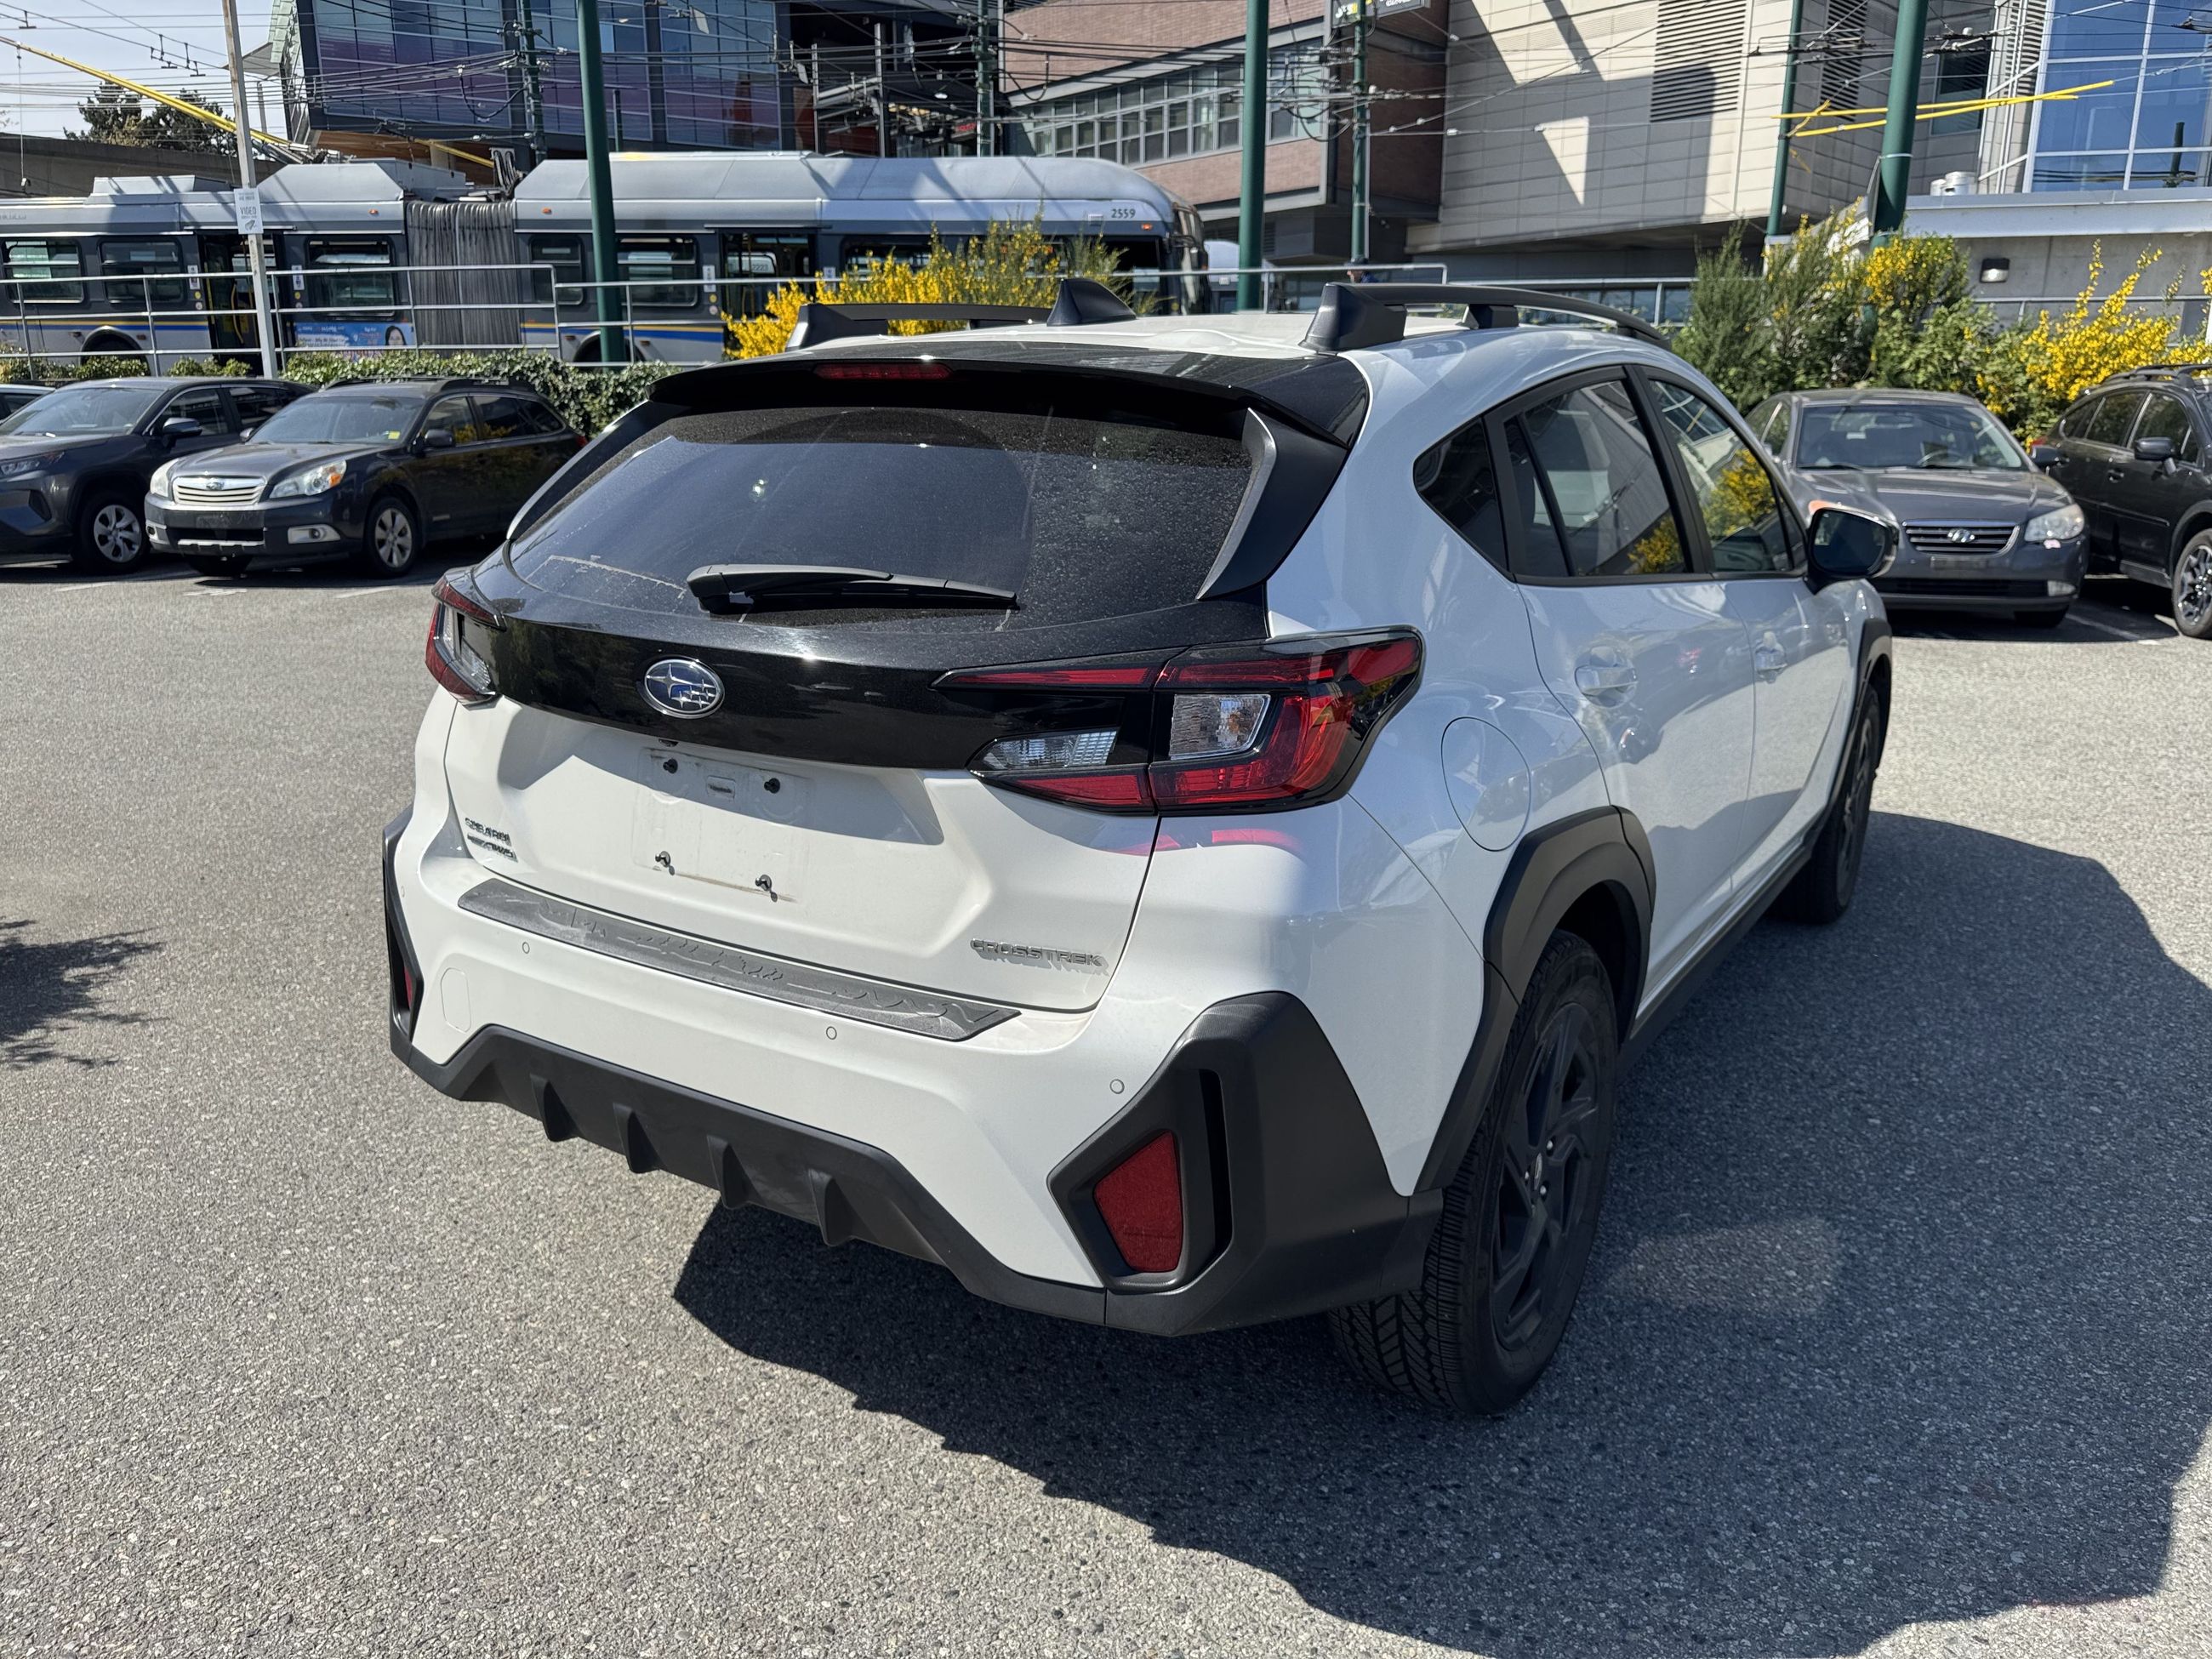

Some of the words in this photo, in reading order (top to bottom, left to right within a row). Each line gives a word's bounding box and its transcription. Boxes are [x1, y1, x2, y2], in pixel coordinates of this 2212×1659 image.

[239, 207, 257, 215] VIDEO
[1111, 208, 1136, 219] 2559
[970, 938, 1104, 967] CROSSTREK
